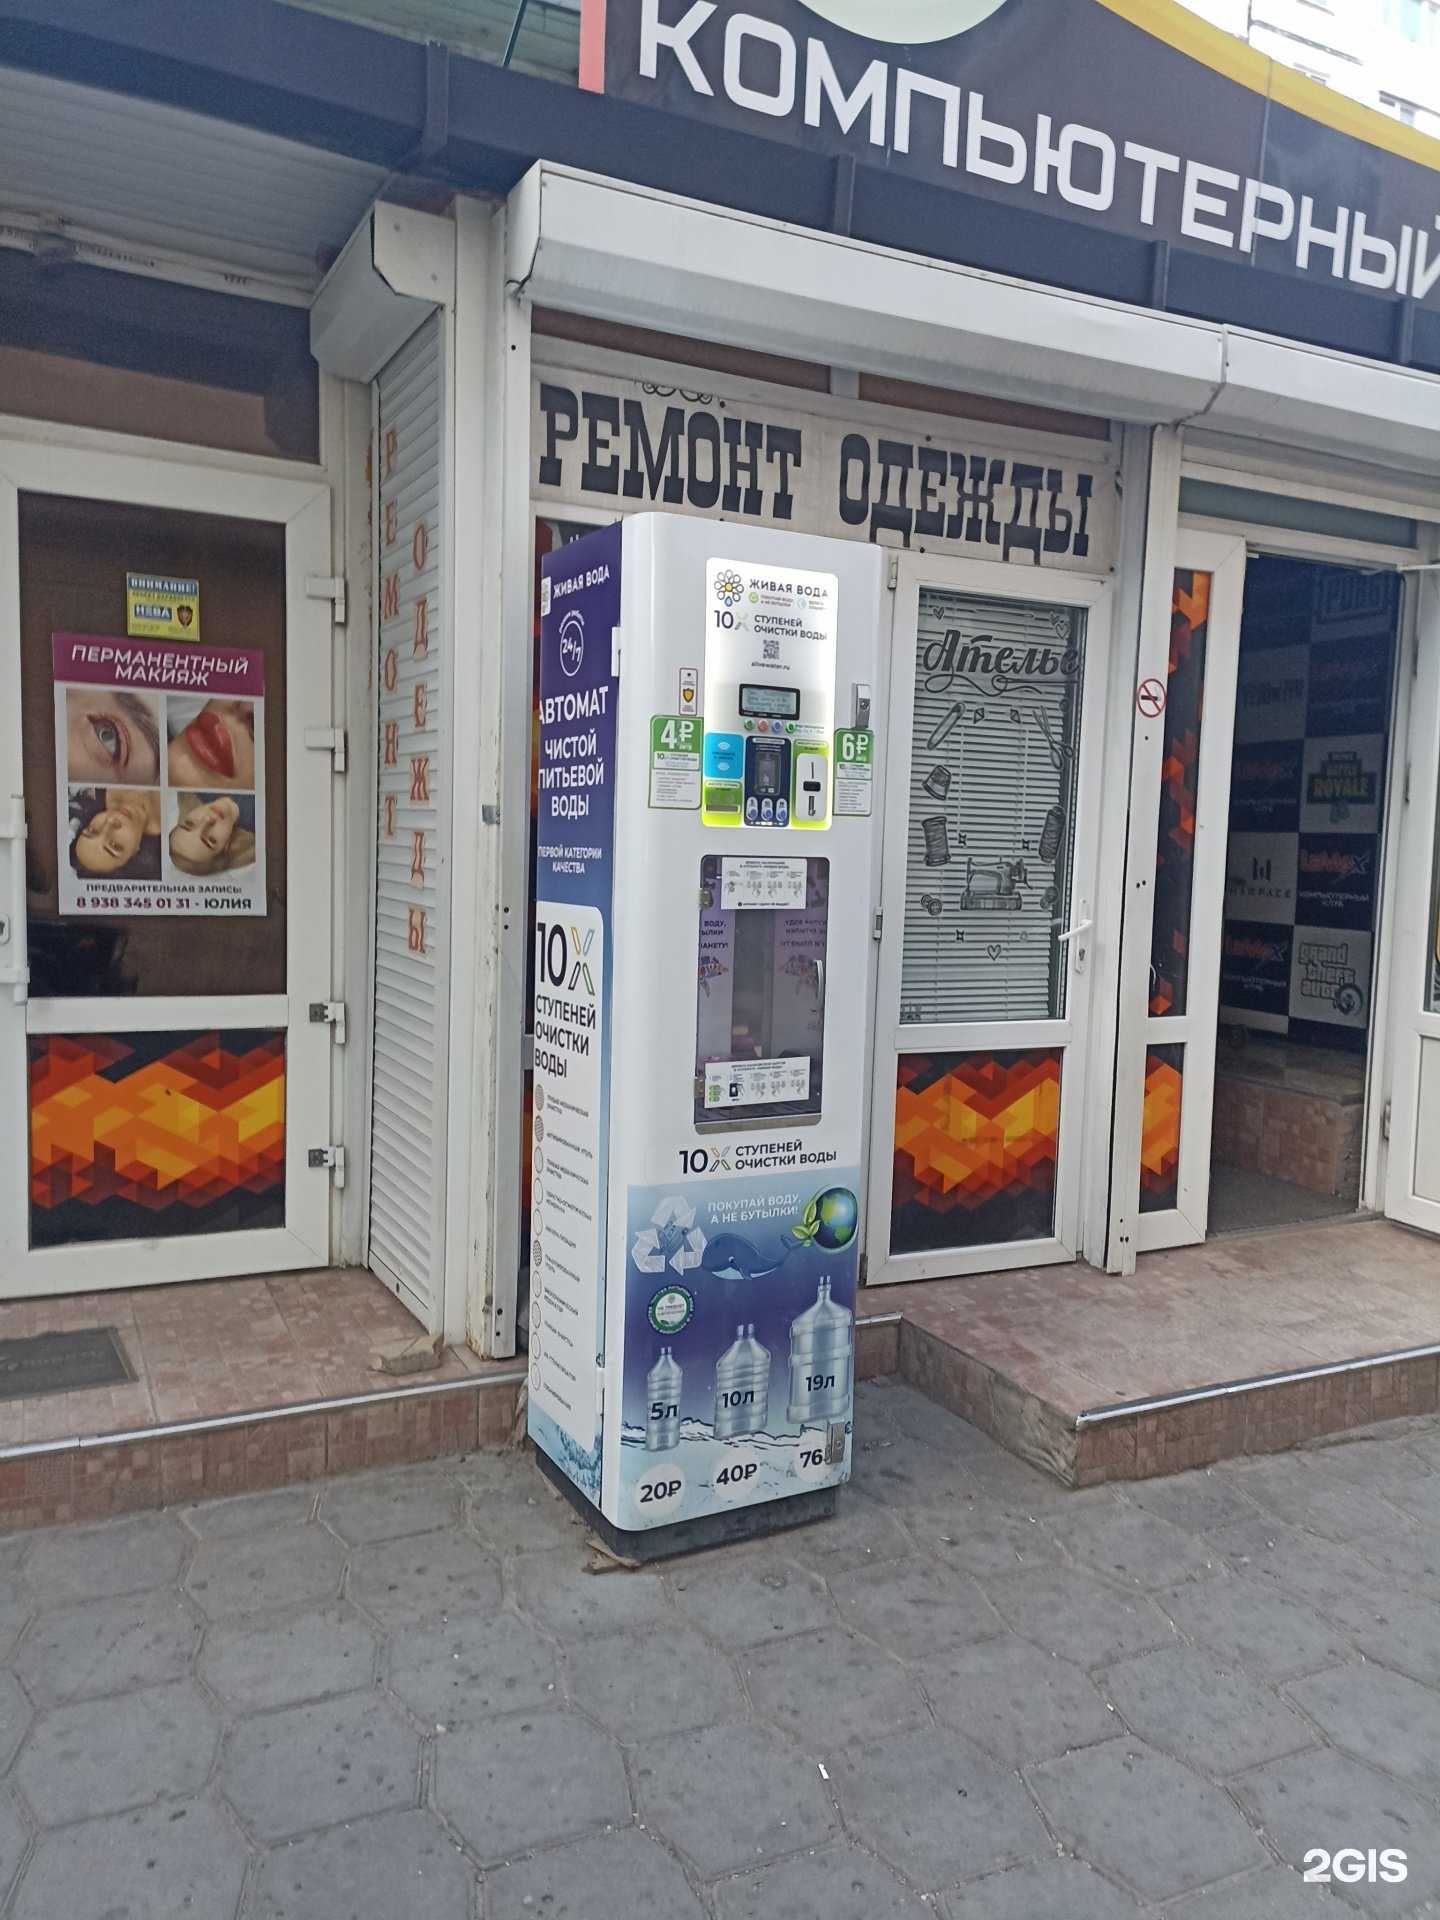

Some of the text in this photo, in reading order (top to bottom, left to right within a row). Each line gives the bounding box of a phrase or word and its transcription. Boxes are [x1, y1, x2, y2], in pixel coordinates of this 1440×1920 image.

[539, 383, 1093, 565] РЕМОНТ ОДЕЖДЫ
[552, 564, 611, 600] ЖИВАЯ ВОДА
[749, 579, 828, 598] ЖИВАЯ ВОДА
[754, 614, 803, 628] СТУПЕНЕЙ
[754, 624, 828, 641] ОЧИСТКИ ВОДЫ
[72, 644, 249, 675] ПЕРМАНЕНТНЫЙ
[561, 637, 582, 663] 24/7
[923, 629, 1080, 678] Ателье
[115, 664, 209, 687] МАКИЯЖ
[545, 728, 597, 761] ЧИСТОЙ
[538, 757, 604, 789] ПИТЬЕВОЙ
[551, 794, 589, 820] ВОДЫ
[564, 847, 602, 860] КАТЕГОРИИ
[552, 861, 585, 874] КАЧЕСТВА
[86, 883, 196, 894] ПРЕДВАРИТЕЛЬНАЯ
[76, 897, 87, 909] 8
[156, 897, 172, 909] 01
[175, 897, 191, 909] 31
[204, 898, 252, 910] ЮЛИЯ
[536, 994, 596, 1030] СТУПЕНЕЙ
[535, 1020, 589, 1056] ОЧИСТКИ
[534, 1047, 567, 1078] ВОДЫ
[735, 1139, 802, 1156] СТУПЕНЕЙ
[735, 1151, 837, 1170] ОЧИСТКИ ВОДЫ
[708, 1197, 766, 1212] ПОКУПАЙ
[710, 1206, 799, 1224] А НЕ БУТЫЛКИ!
[805, 1374, 835, 1391] 19л
[721, 1390, 755, 1408] 10л
